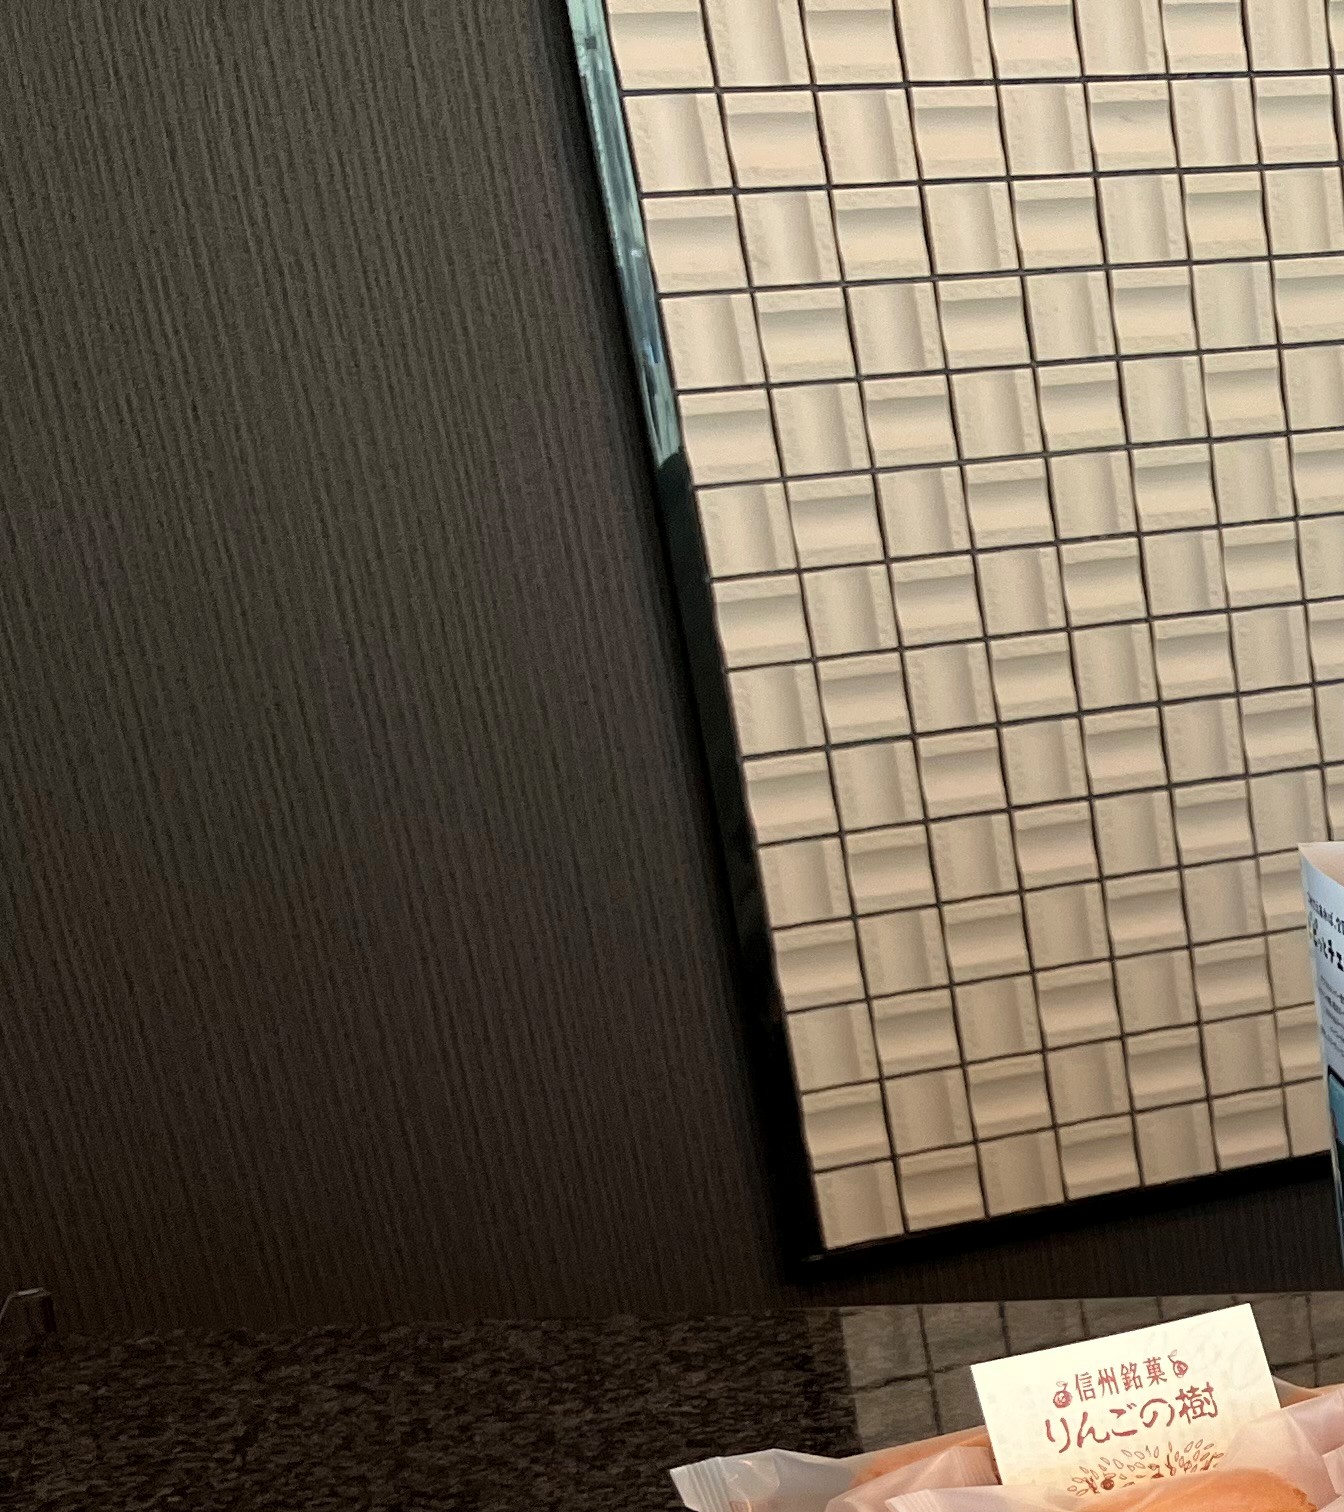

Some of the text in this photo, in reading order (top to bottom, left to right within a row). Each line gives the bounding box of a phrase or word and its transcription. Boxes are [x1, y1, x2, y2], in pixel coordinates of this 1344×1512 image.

[1075, 1356, 1168, 1402] 信州銘菓
[1045, 1381, 1219, 1454] りんごの樹
